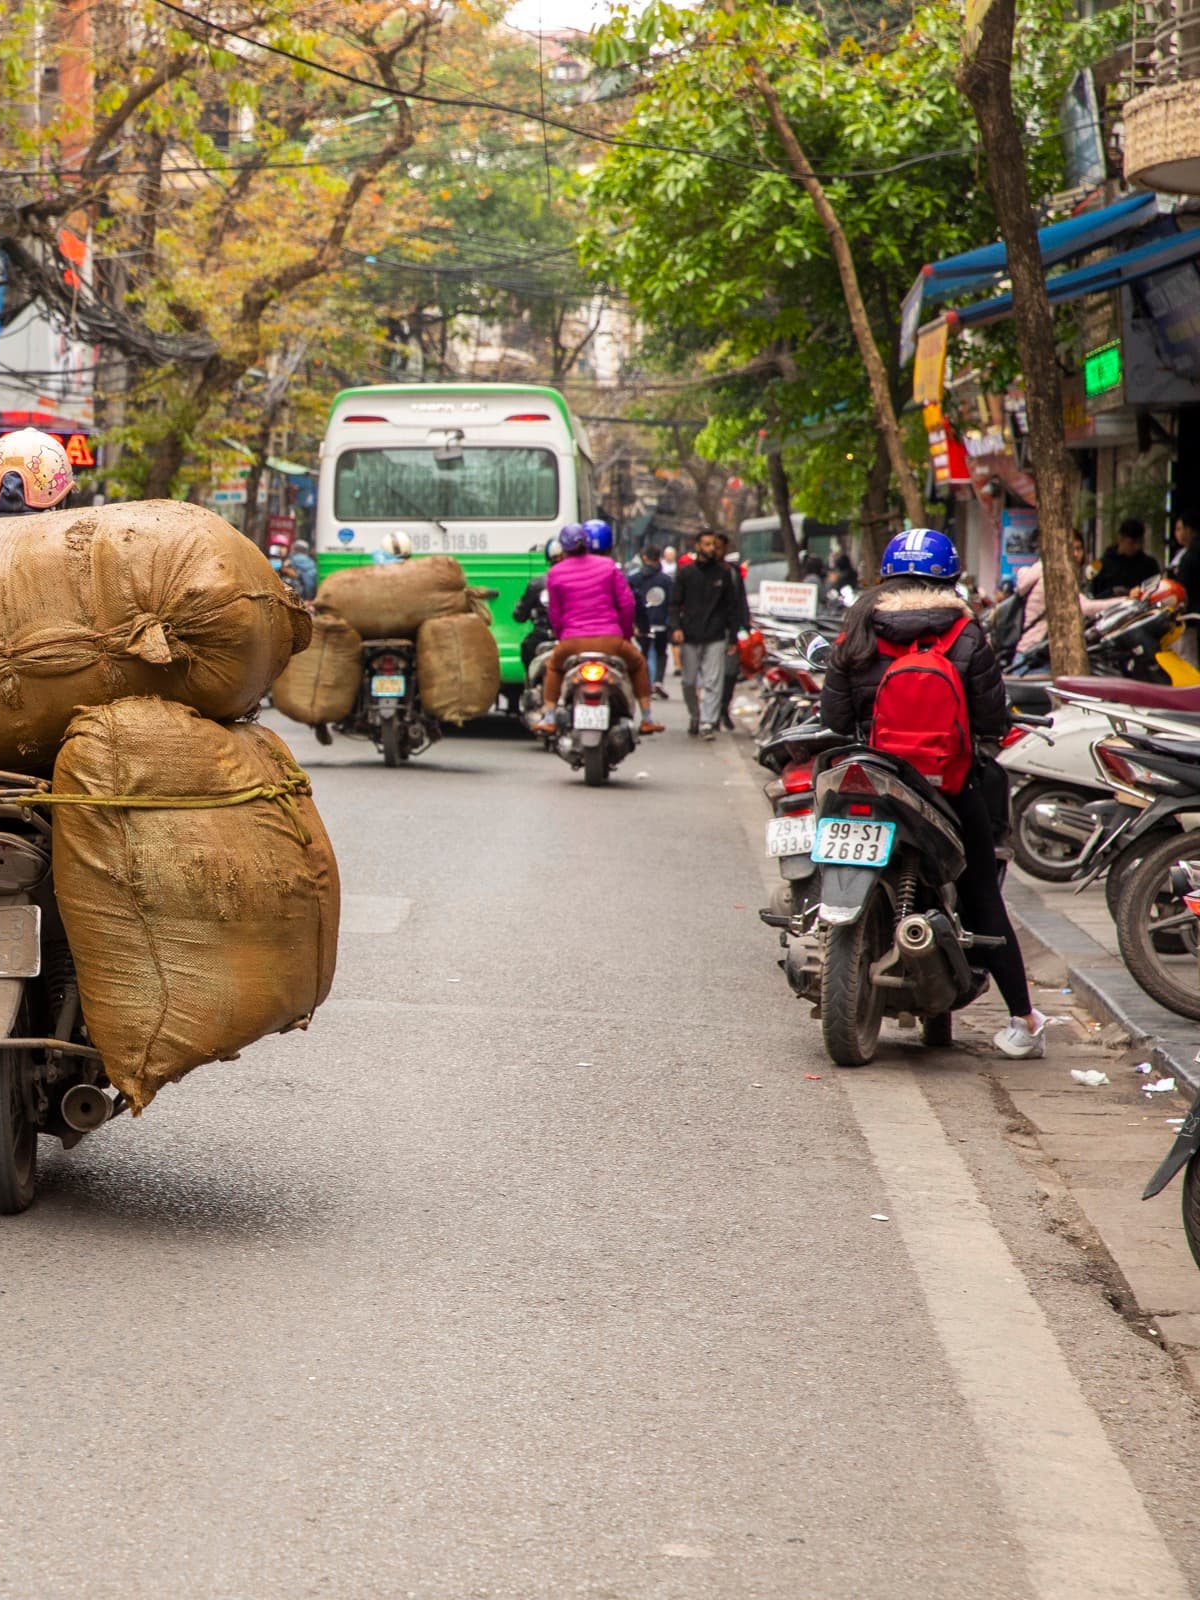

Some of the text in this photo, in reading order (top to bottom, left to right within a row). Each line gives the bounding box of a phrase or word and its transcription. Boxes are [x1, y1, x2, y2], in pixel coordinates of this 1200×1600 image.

[829, 822, 882, 842] 99-S1
[771, 835, 812, 855] 033.6
[824, 842, 879, 861] 2683
